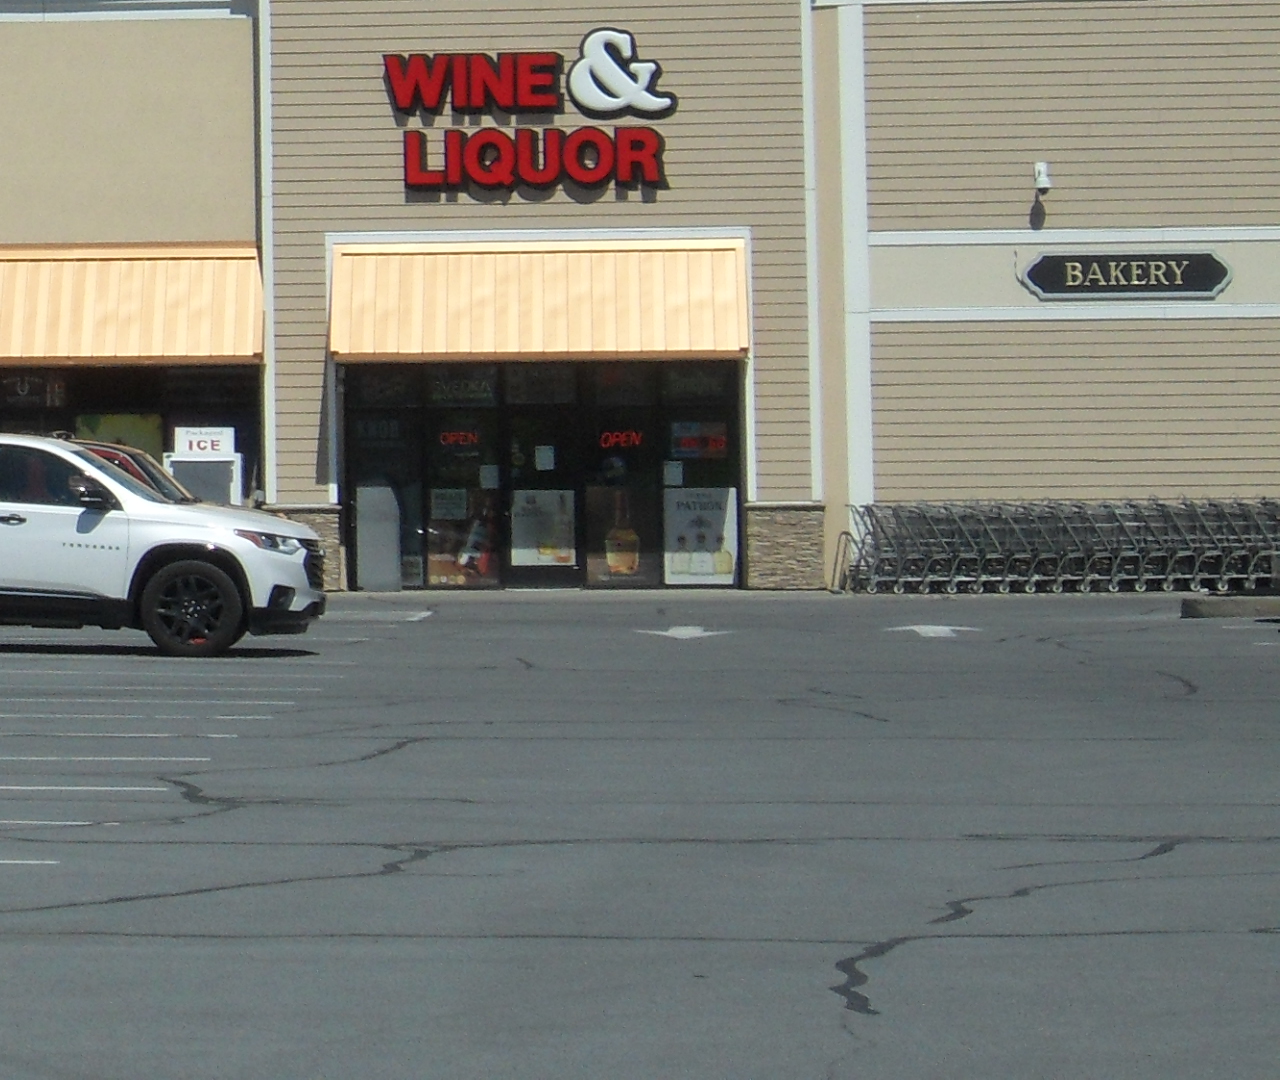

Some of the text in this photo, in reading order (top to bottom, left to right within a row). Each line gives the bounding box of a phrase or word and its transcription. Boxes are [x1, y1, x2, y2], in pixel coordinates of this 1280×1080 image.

[383, 27, 678, 120] WINE &
[402, 126, 662, 188] LIQUOR
[1064, 260, 1190, 286] BAKERY
[188, 439, 221, 452] ICE
[440, 432, 479, 446] OPEN
[600, 431, 642, 449] OPEN
